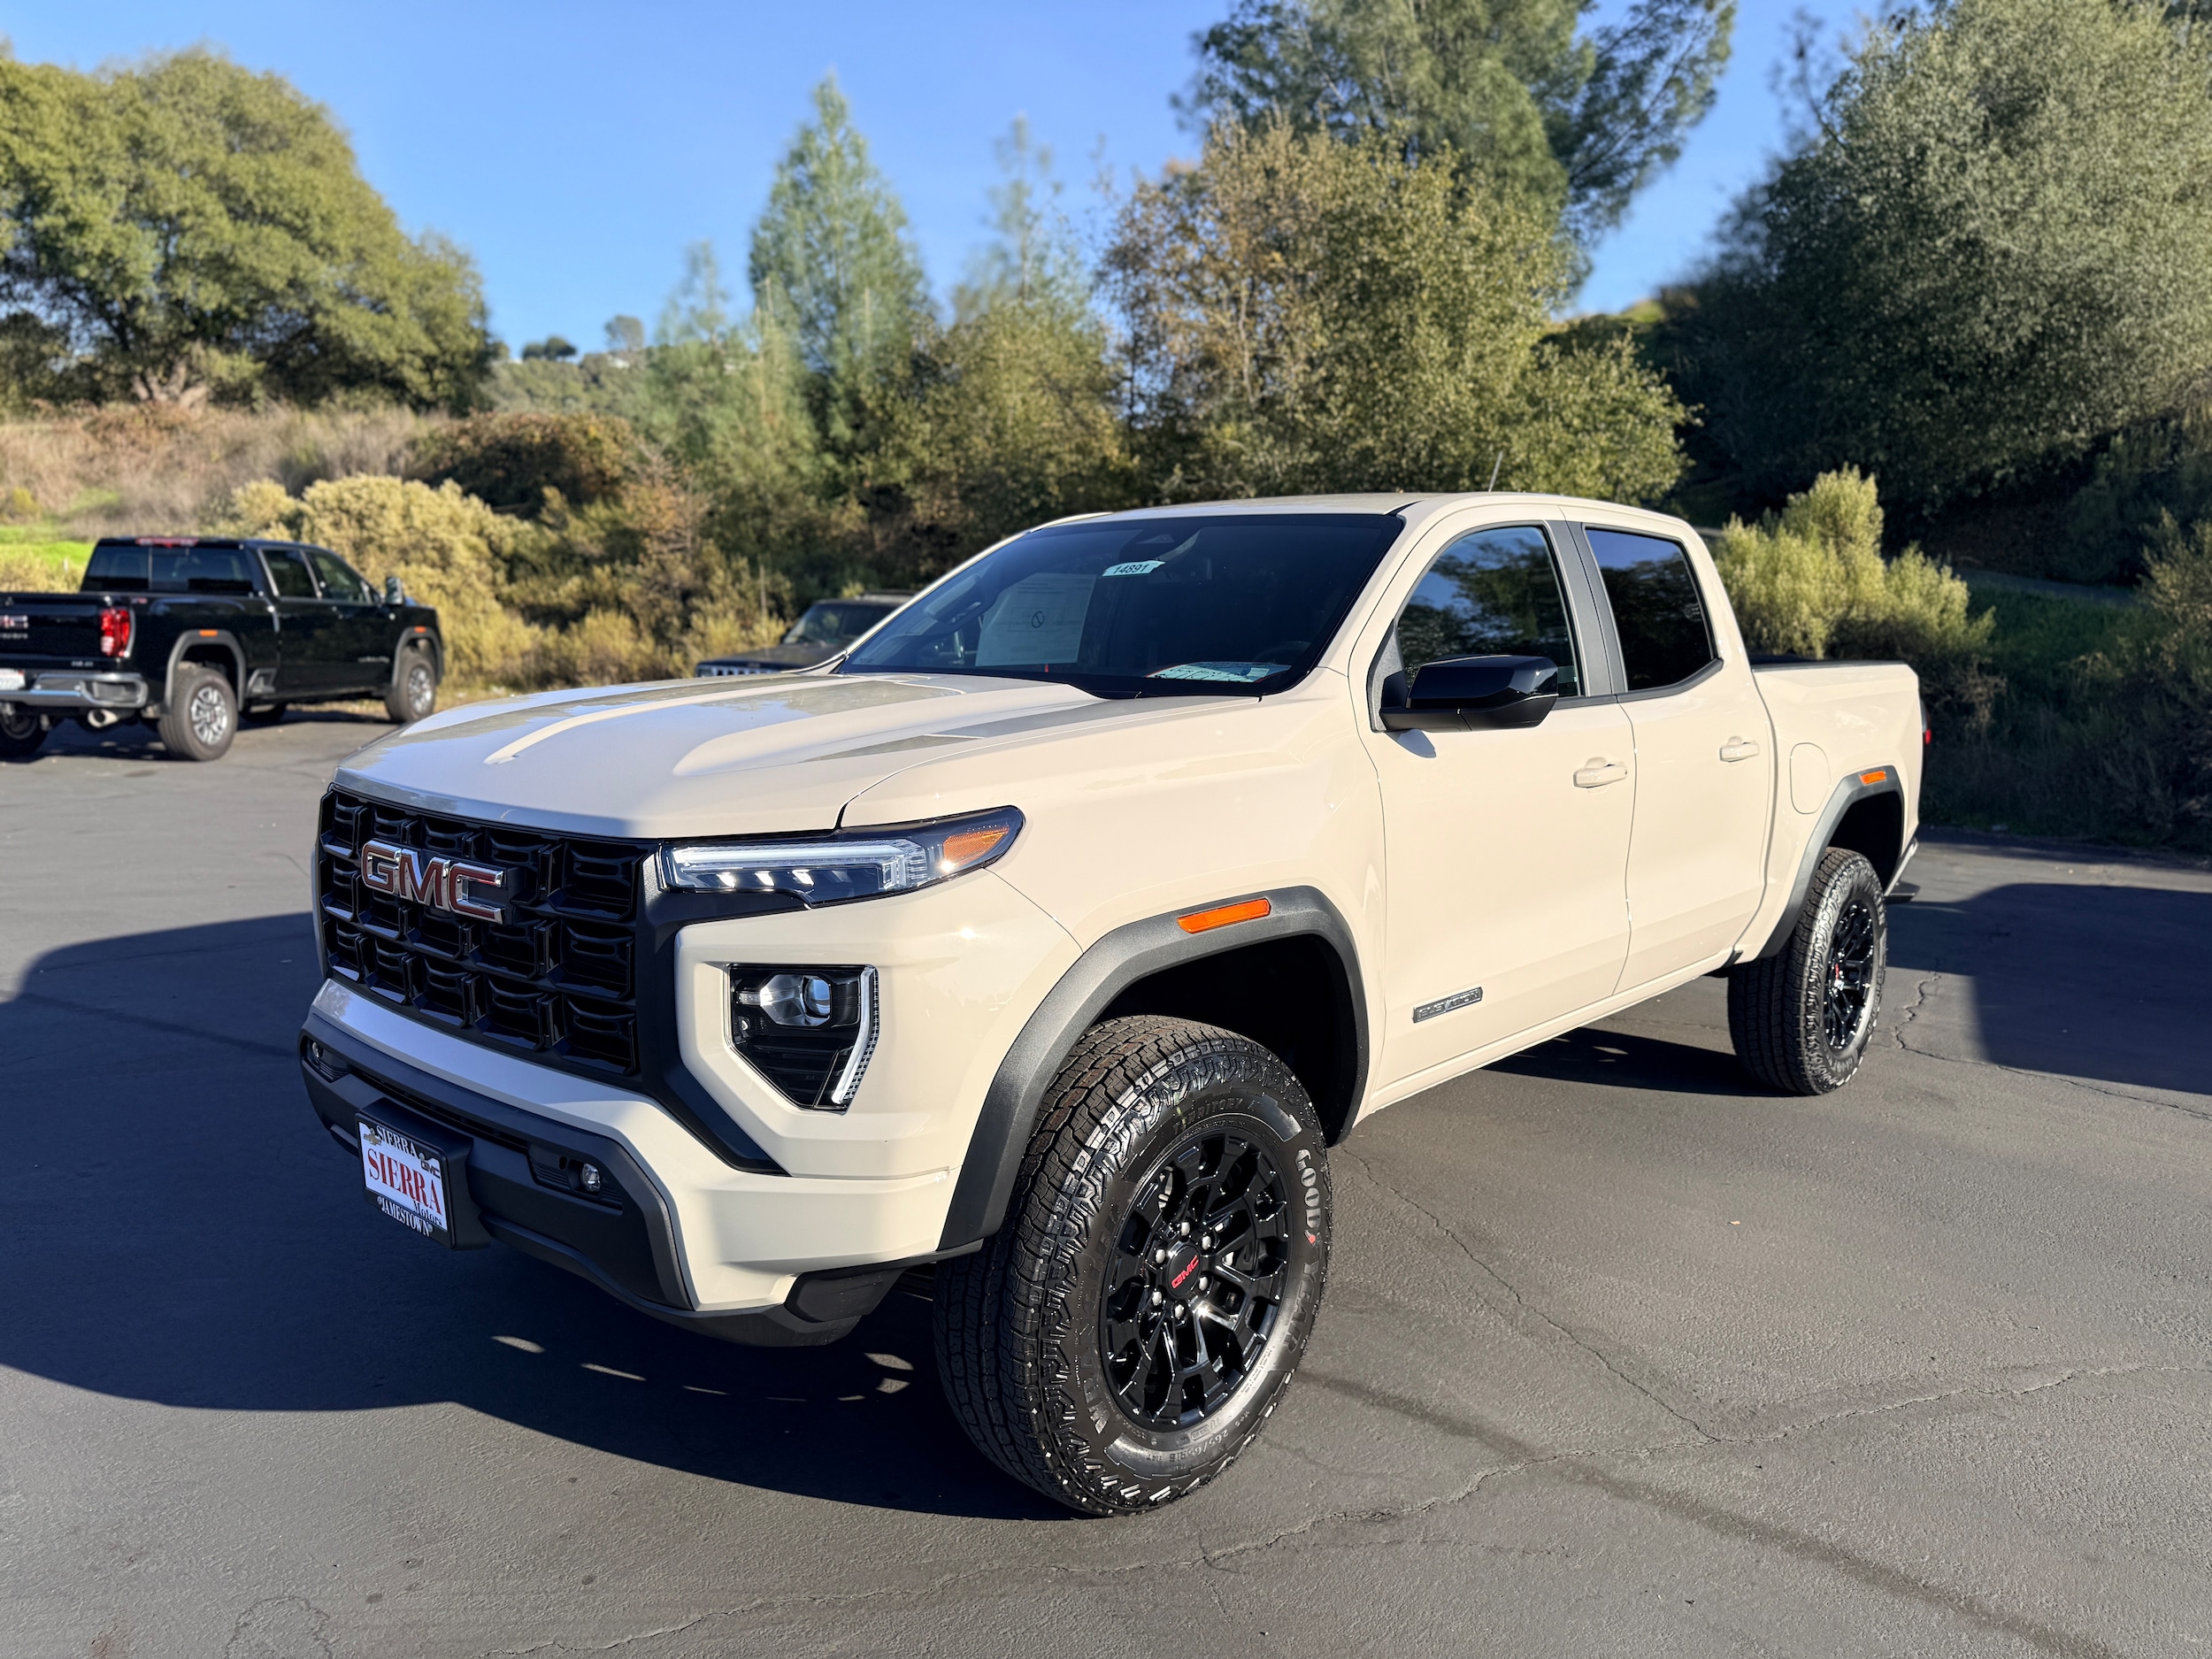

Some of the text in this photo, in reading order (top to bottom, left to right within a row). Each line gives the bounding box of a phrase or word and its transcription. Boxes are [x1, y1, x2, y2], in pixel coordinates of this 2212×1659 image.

[1113, 564, 1149, 574] 14891
[362, 840, 504, 924] GMC
[376, 1125, 419, 1158] SIERRA
[367, 1148, 442, 1215] SIERRA
[420, 1160, 441, 1179] GMC
[380, 1198, 430, 1237] JAMESTOWN
[413, 1201, 442, 1226] Motors
[1171, 1255, 1199, 1288] GMC
